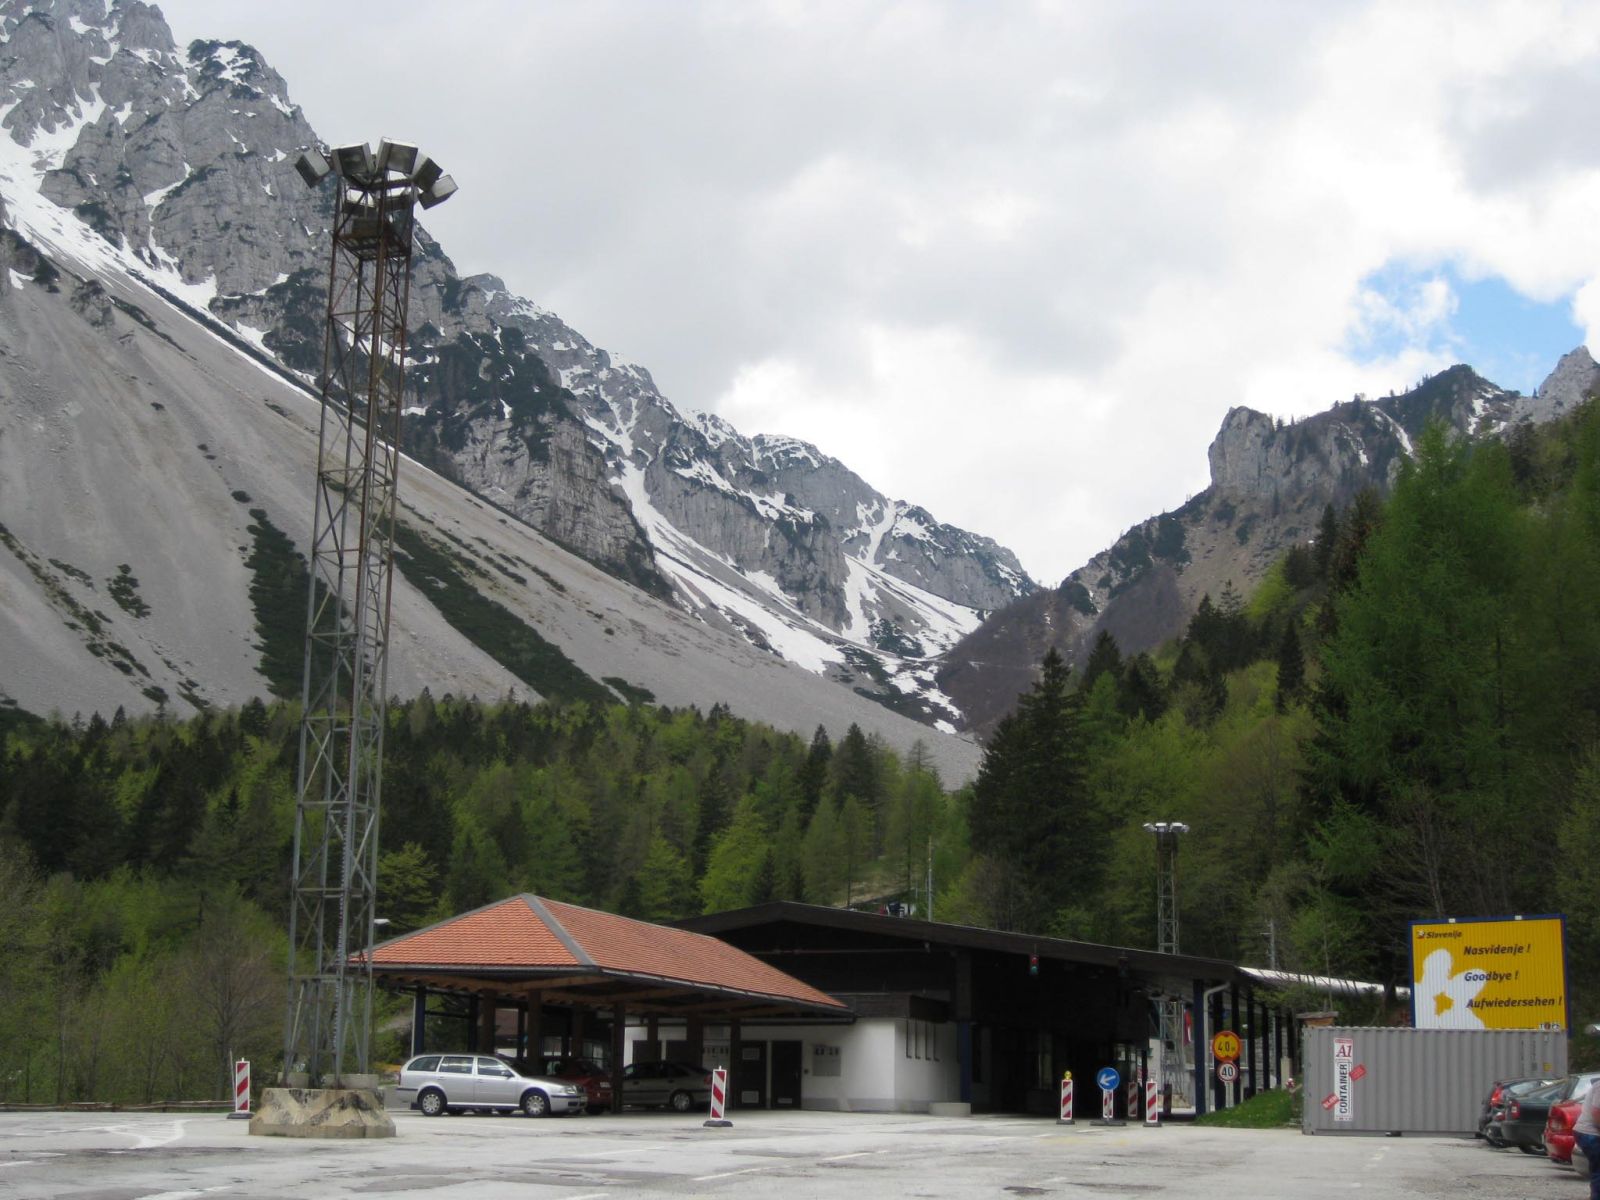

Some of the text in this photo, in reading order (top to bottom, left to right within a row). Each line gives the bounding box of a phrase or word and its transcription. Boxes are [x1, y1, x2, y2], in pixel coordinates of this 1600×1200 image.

[1464, 944, 1524, 956] Nasvidenje
[1464, 971, 1512, 983] Goodbye
[1466, 996, 1555, 1010] Aufwiedersehen
[1221, 1066, 1233, 1077] 40
[1339, 1064, 1348, 1114] CONTAINER
